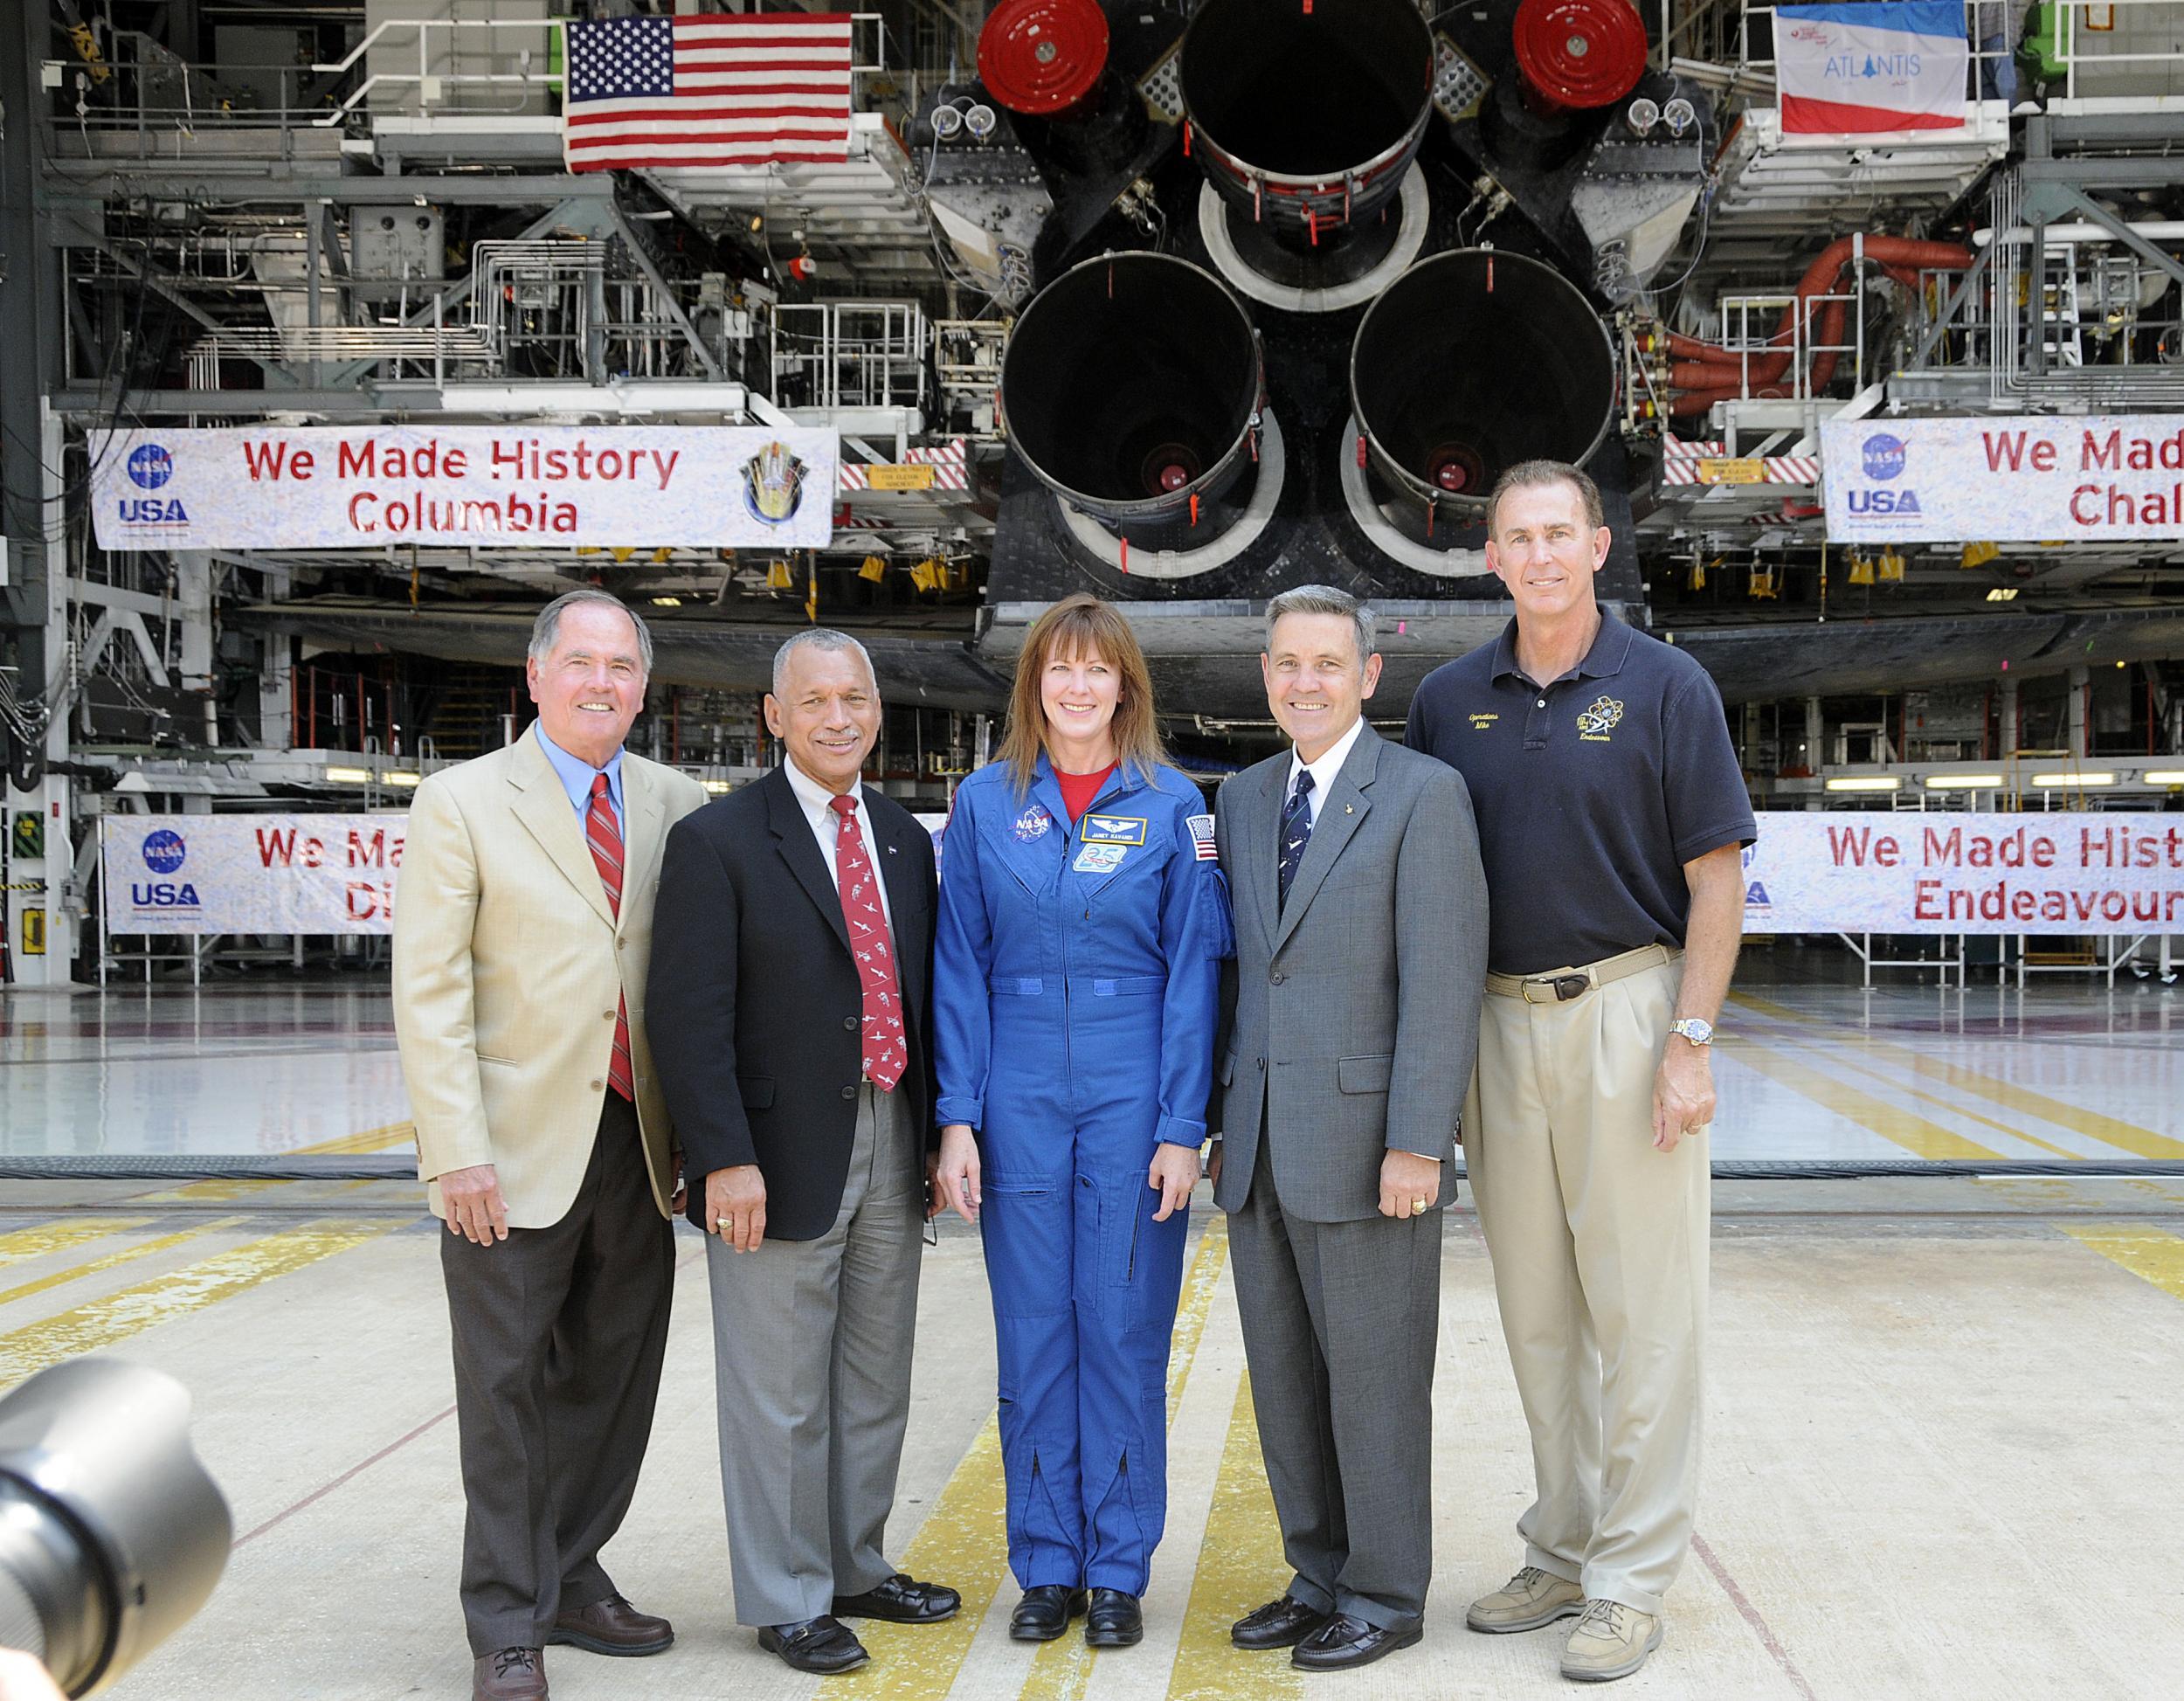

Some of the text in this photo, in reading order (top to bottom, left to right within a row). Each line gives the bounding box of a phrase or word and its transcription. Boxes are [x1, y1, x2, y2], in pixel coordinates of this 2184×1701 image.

[1823, 53, 1921, 78] ATLANTIS
[244, 439, 681, 491] We Made History
[1863, 451, 1904, 464] NASA
[1983, 427, 2184, 473] We Mad
[119, 499, 189, 522] USA
[349, 491, 578, 533] Columbia
[1849, 490, 1921, 513] USA
[2070, 482, 2181, 526] Chal
[1016, 818, 1049, 829] NASA
[143, 846, 185, 858] NASA
[256, 827, 324, 868] We
[1828, 826, 2182, 868] We Made Hist
[132, 883, 200, 906] USA
[347, 882, 391, 921] Di
[1915, 880, 2184, 922] Endeavour
